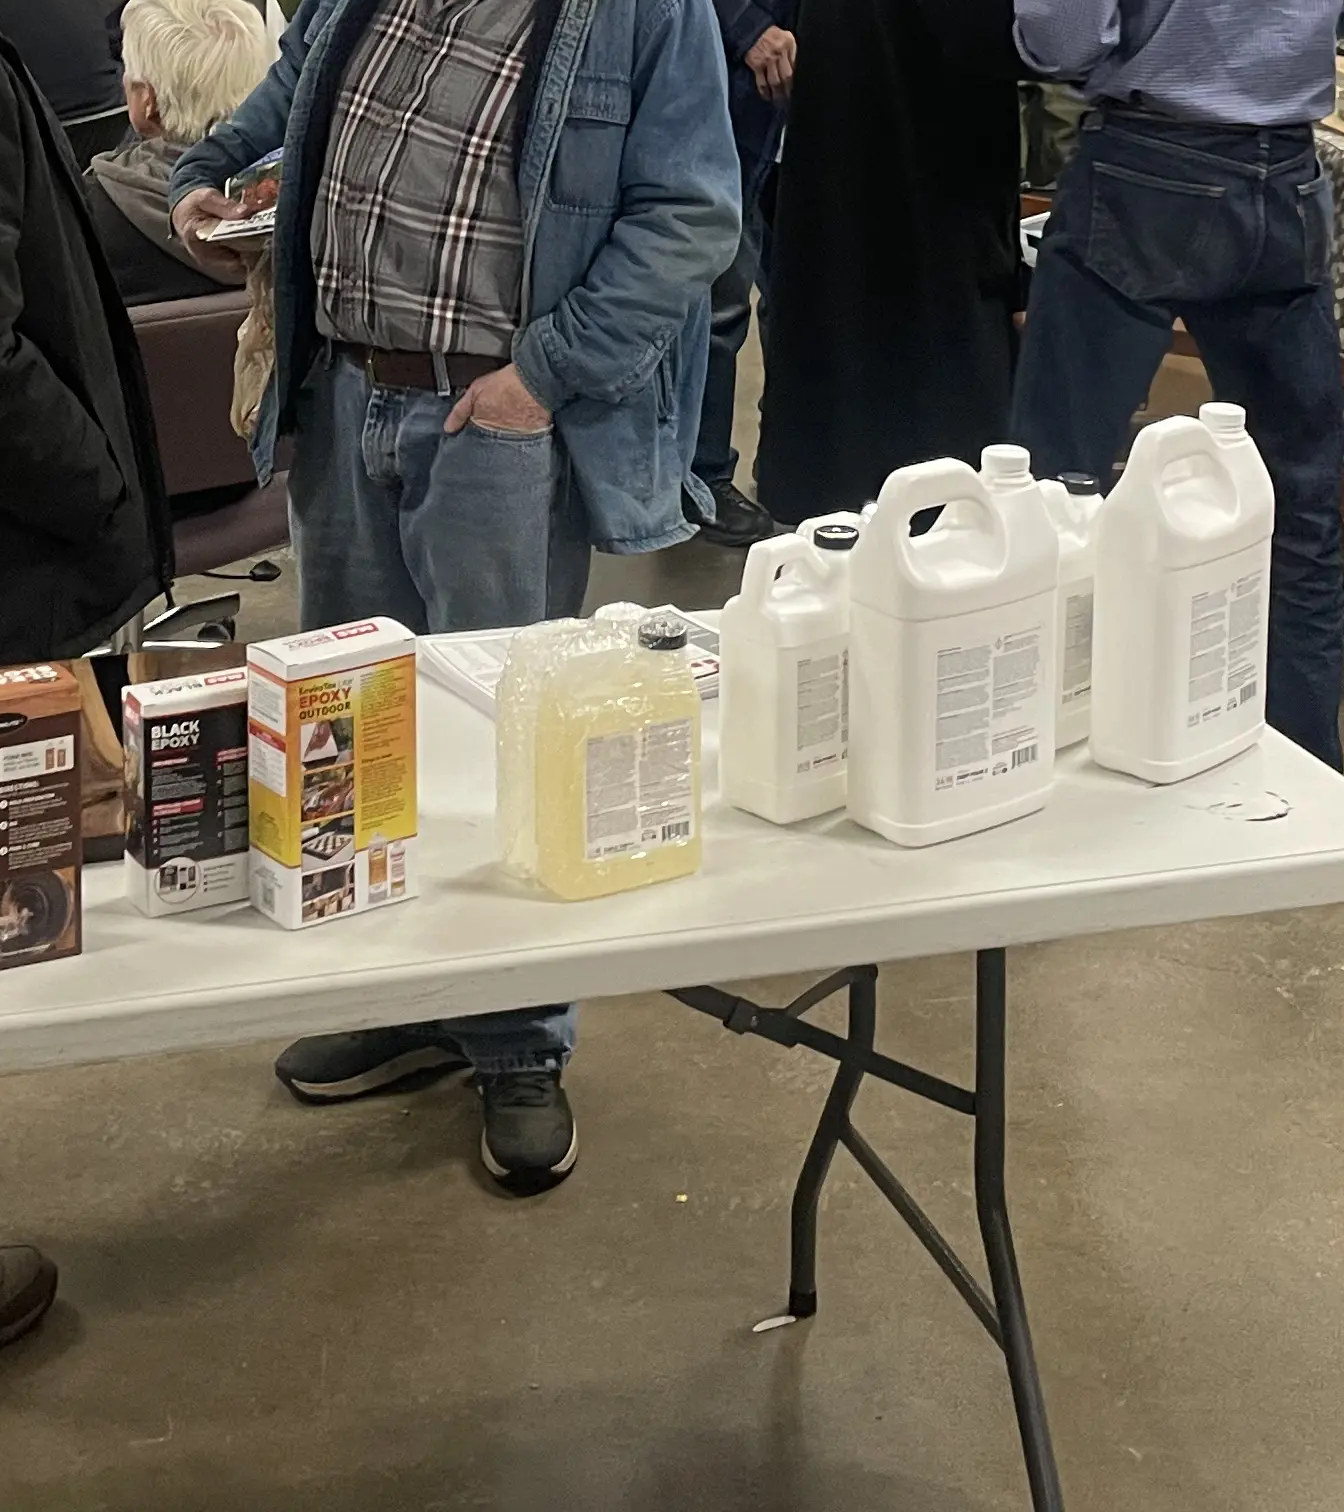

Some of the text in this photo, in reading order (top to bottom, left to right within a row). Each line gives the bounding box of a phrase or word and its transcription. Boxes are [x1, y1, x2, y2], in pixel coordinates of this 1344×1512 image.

[299, 686, 353, 709] EPOXY
[299, 701, 351, 720] OUTDOOR
[151, 719, 200, 739] BLACK
[151, 733, 200, 751] EPOXY
